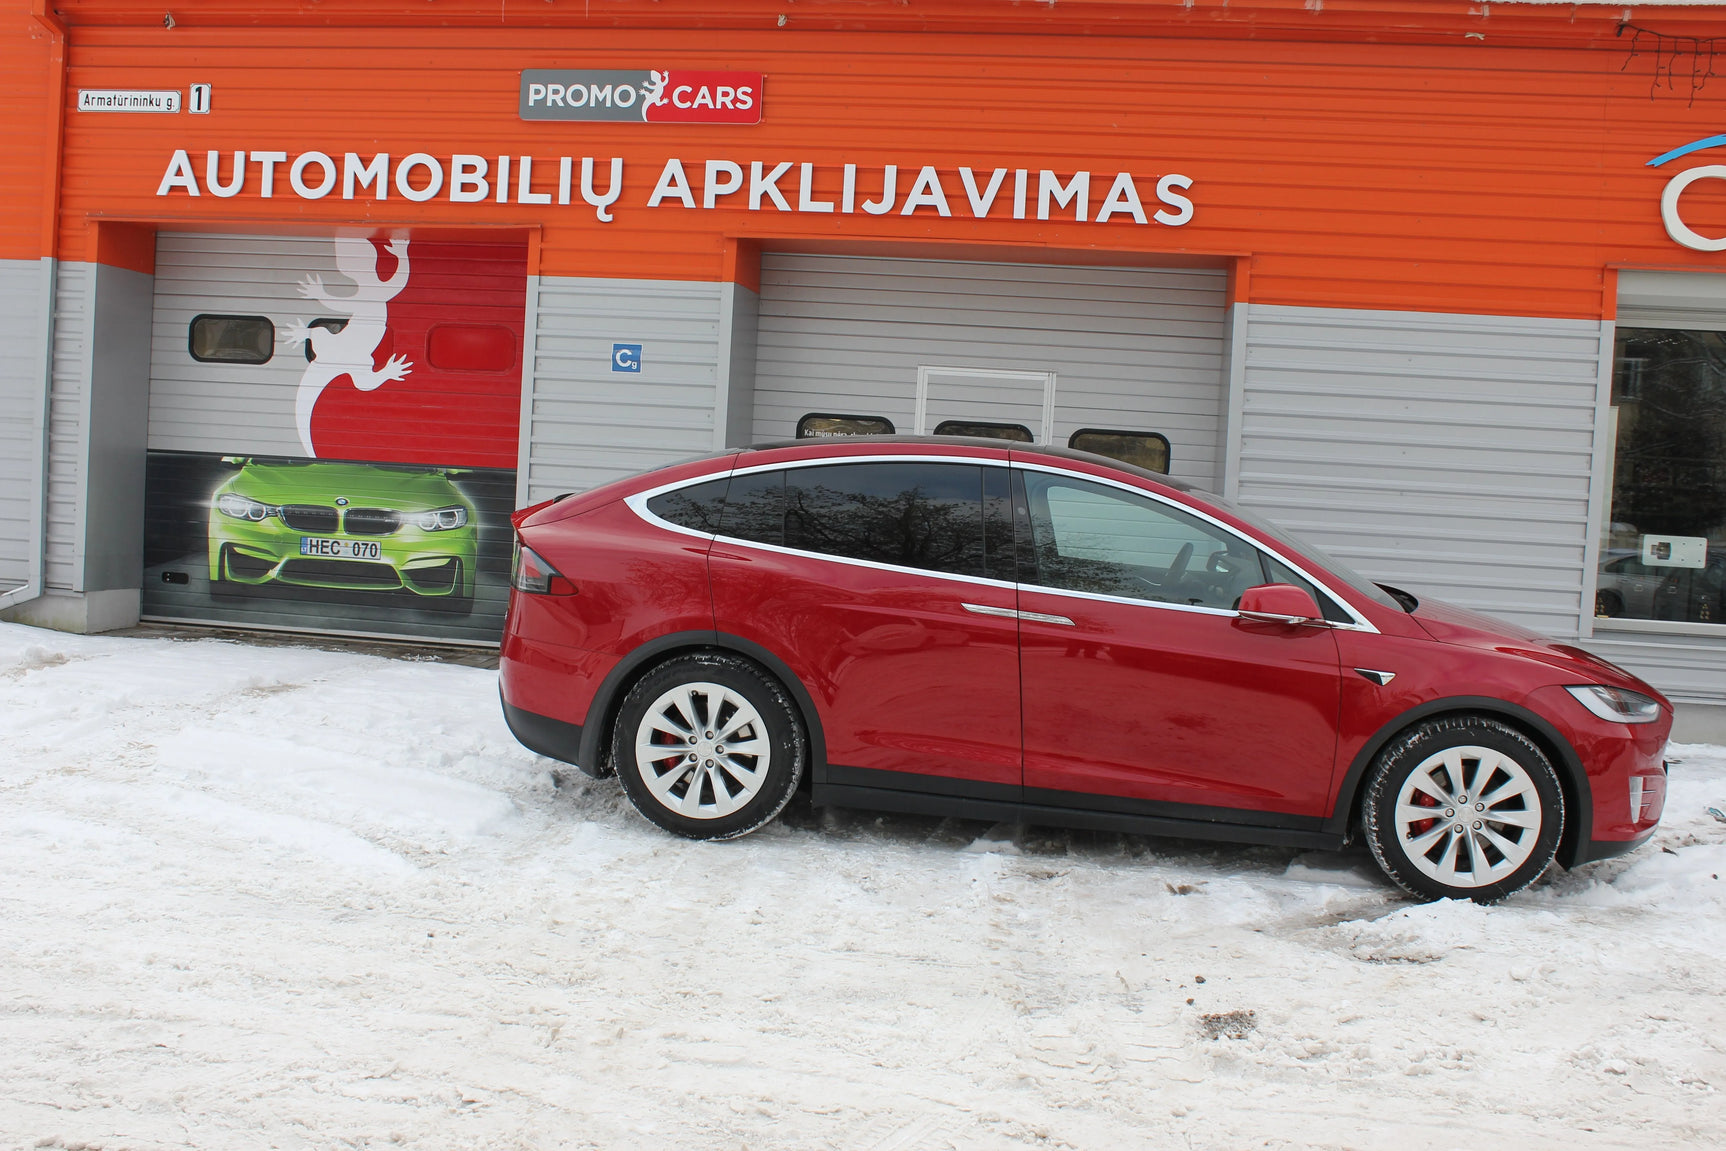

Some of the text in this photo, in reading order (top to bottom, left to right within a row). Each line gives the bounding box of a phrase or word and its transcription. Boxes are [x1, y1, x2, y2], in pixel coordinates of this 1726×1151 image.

[195, 86, 203, 111] 1
[528, 83, 753, 110] PROMO CARS
[156, 149, 1194, 226] AUTOMOBILIŲ APKLIJAVIMAS
[309, 539, 378, 558] HEC 070
